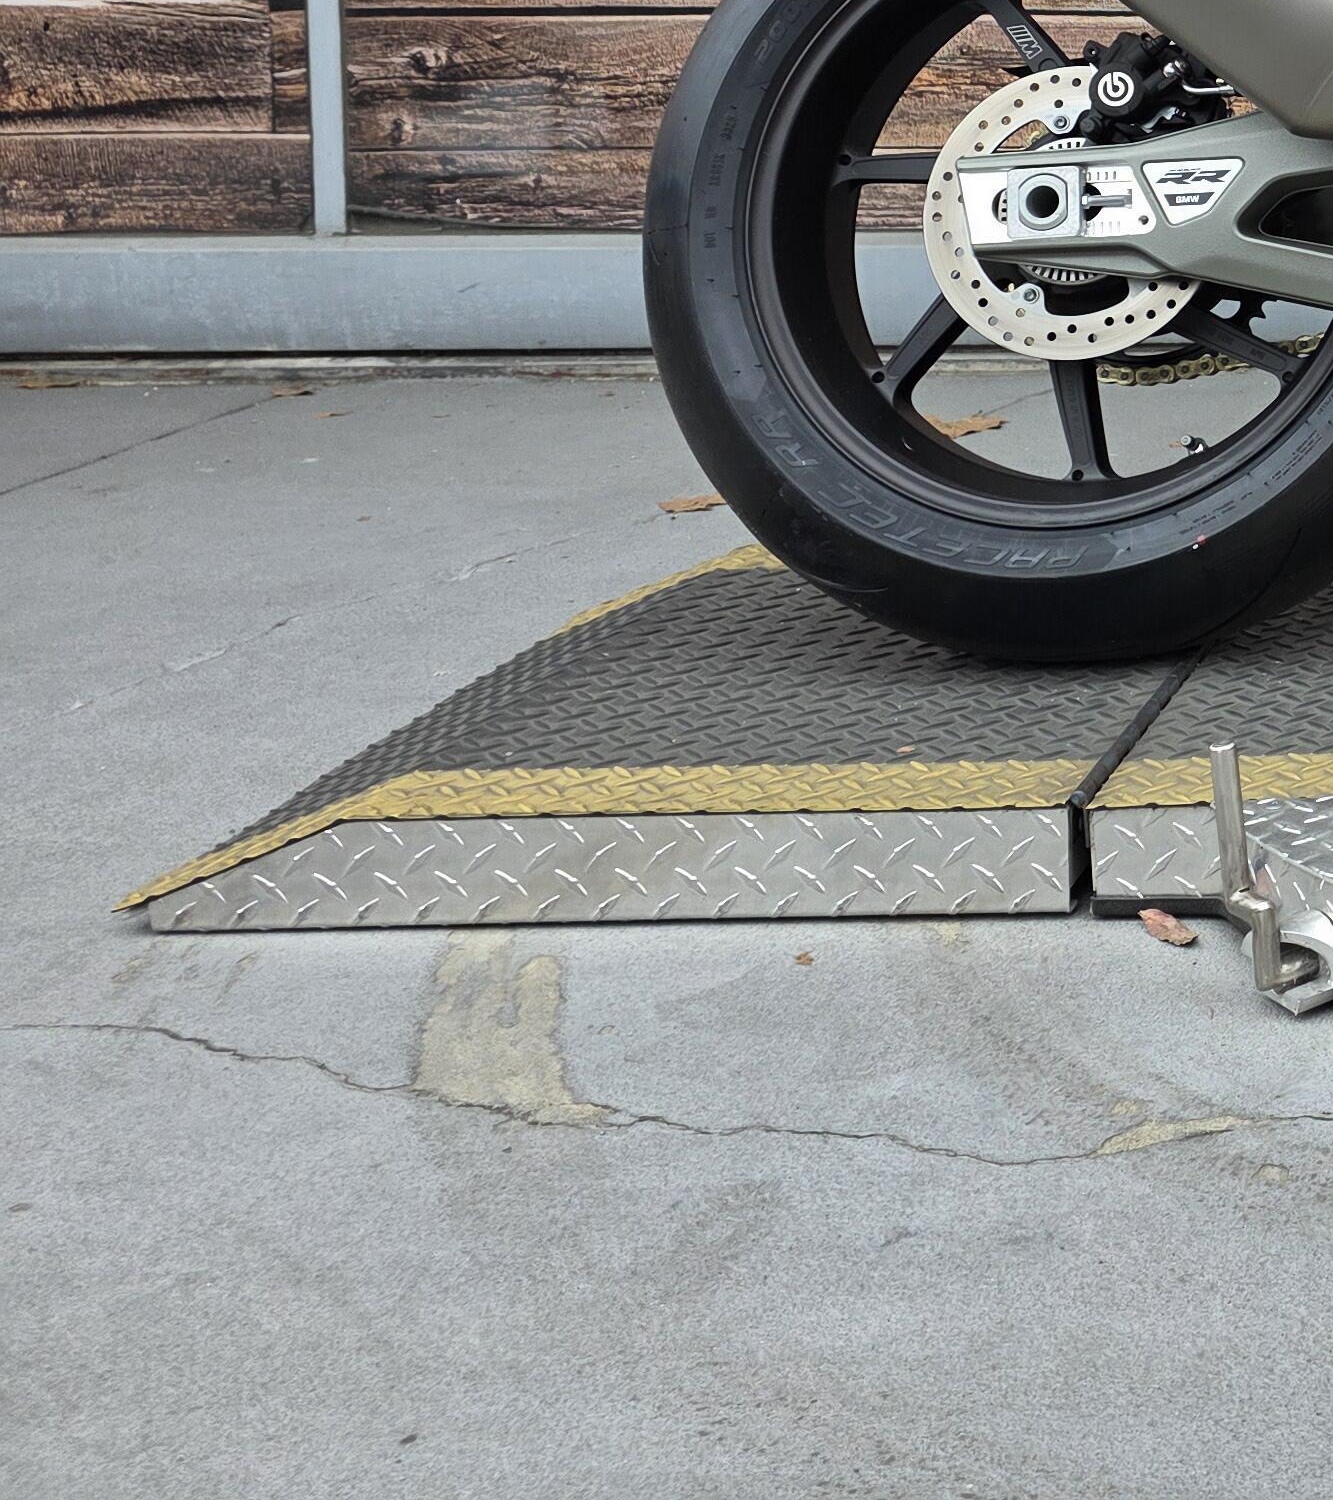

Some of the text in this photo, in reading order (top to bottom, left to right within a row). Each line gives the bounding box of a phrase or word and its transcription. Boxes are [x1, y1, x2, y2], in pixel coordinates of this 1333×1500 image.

[1156, 169, 1232, 185] RR
[1175, 194, 1200, 204] BMW
[751, 410, 1089, 570] RACETEC RR
